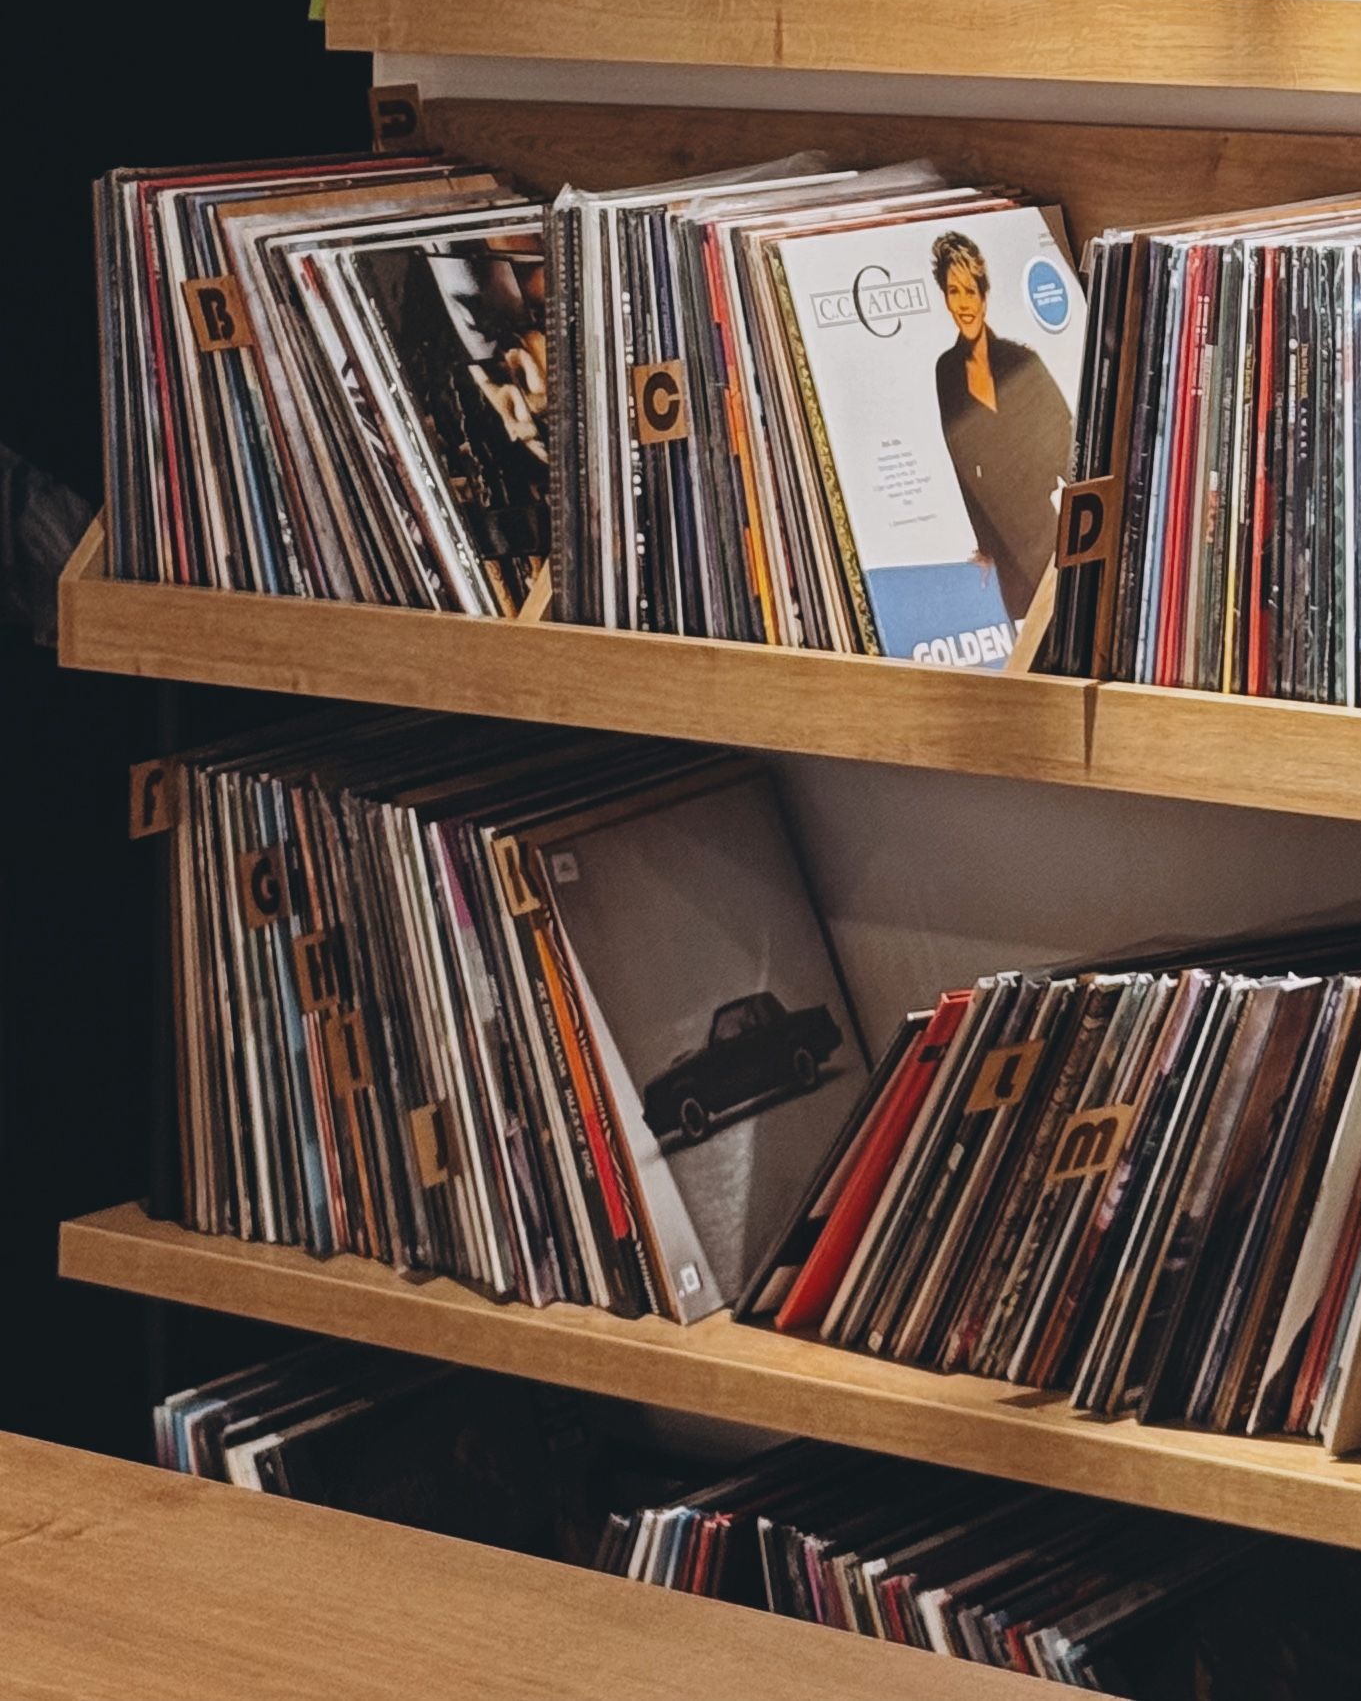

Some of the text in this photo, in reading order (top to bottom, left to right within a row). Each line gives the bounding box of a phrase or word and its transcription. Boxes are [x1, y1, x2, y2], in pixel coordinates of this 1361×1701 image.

[197, 286, 236, 342] B
[641, 371, 681, 432] C
[1067, 493, 1104, 555] D
[912, 623, 1016, 668] GOLDEN
[251, 854, 282, 916] G
[992, 1052, 1022, 1100] L
